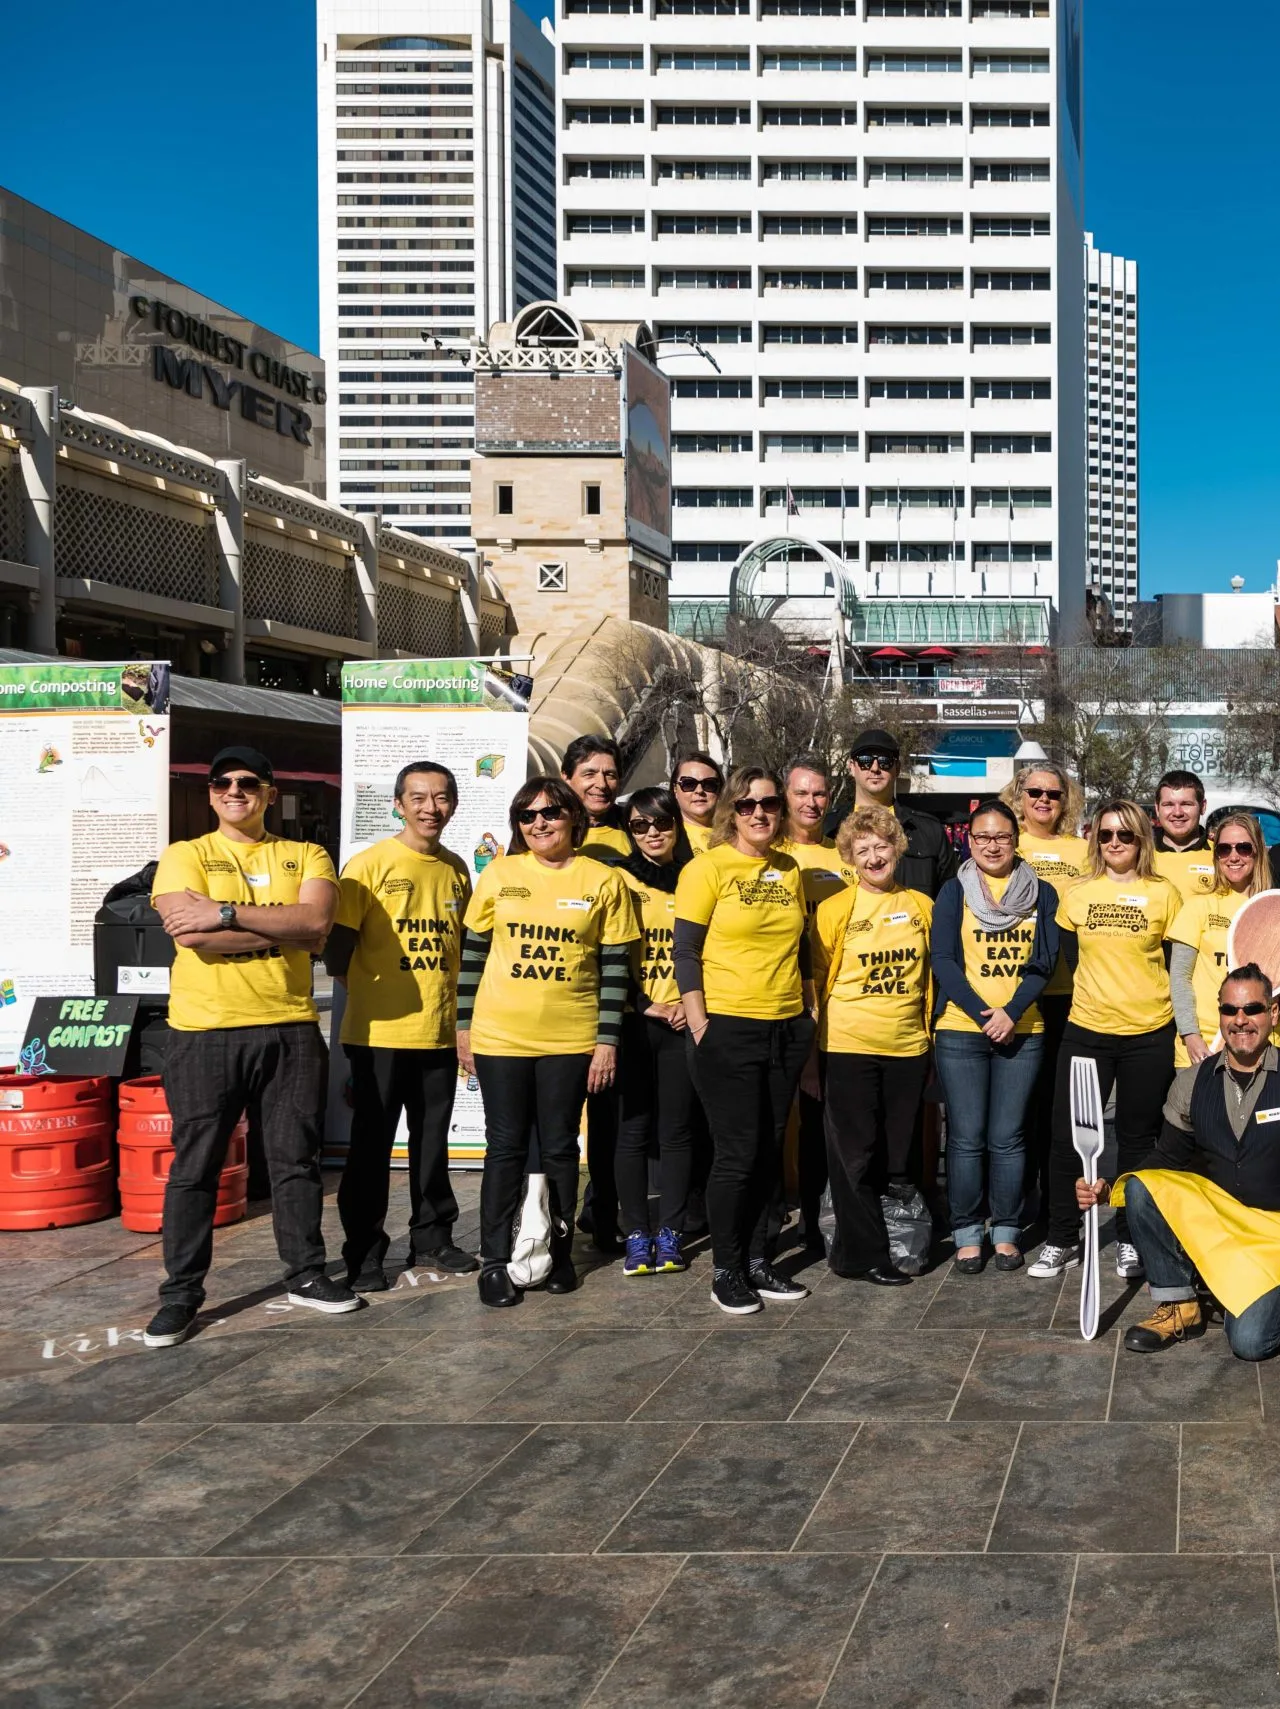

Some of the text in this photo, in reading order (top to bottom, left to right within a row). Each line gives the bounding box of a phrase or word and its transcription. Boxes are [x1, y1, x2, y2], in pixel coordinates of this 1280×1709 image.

[155, 300, 312, 403] FORREST CHASE
[154, 346, 312, 446] MYER
[30, 679, 117, 695] Composting
[344, 675, 480, 692] Home Composting
[944, 706, 987, 717] sassellas
[1093, 912, 1140, 920] OZHARVEST
[506, 922, 580, 944] THINK.
[520, 944, 564, 962] EAT.
[858, 947, 921, 967] THINK.
[987, 946, 1024, 960] EAT.
[510, 963, 572, 981] SAVE.
[870, 965, 905, 981] EAT.
[860, 980, 910, 995] SAVE.
[59, 999, 109, 1022] FREE
[48, 1024, 131, 1048] COMPOST
[20, 1115, 79, 1131] WATER
